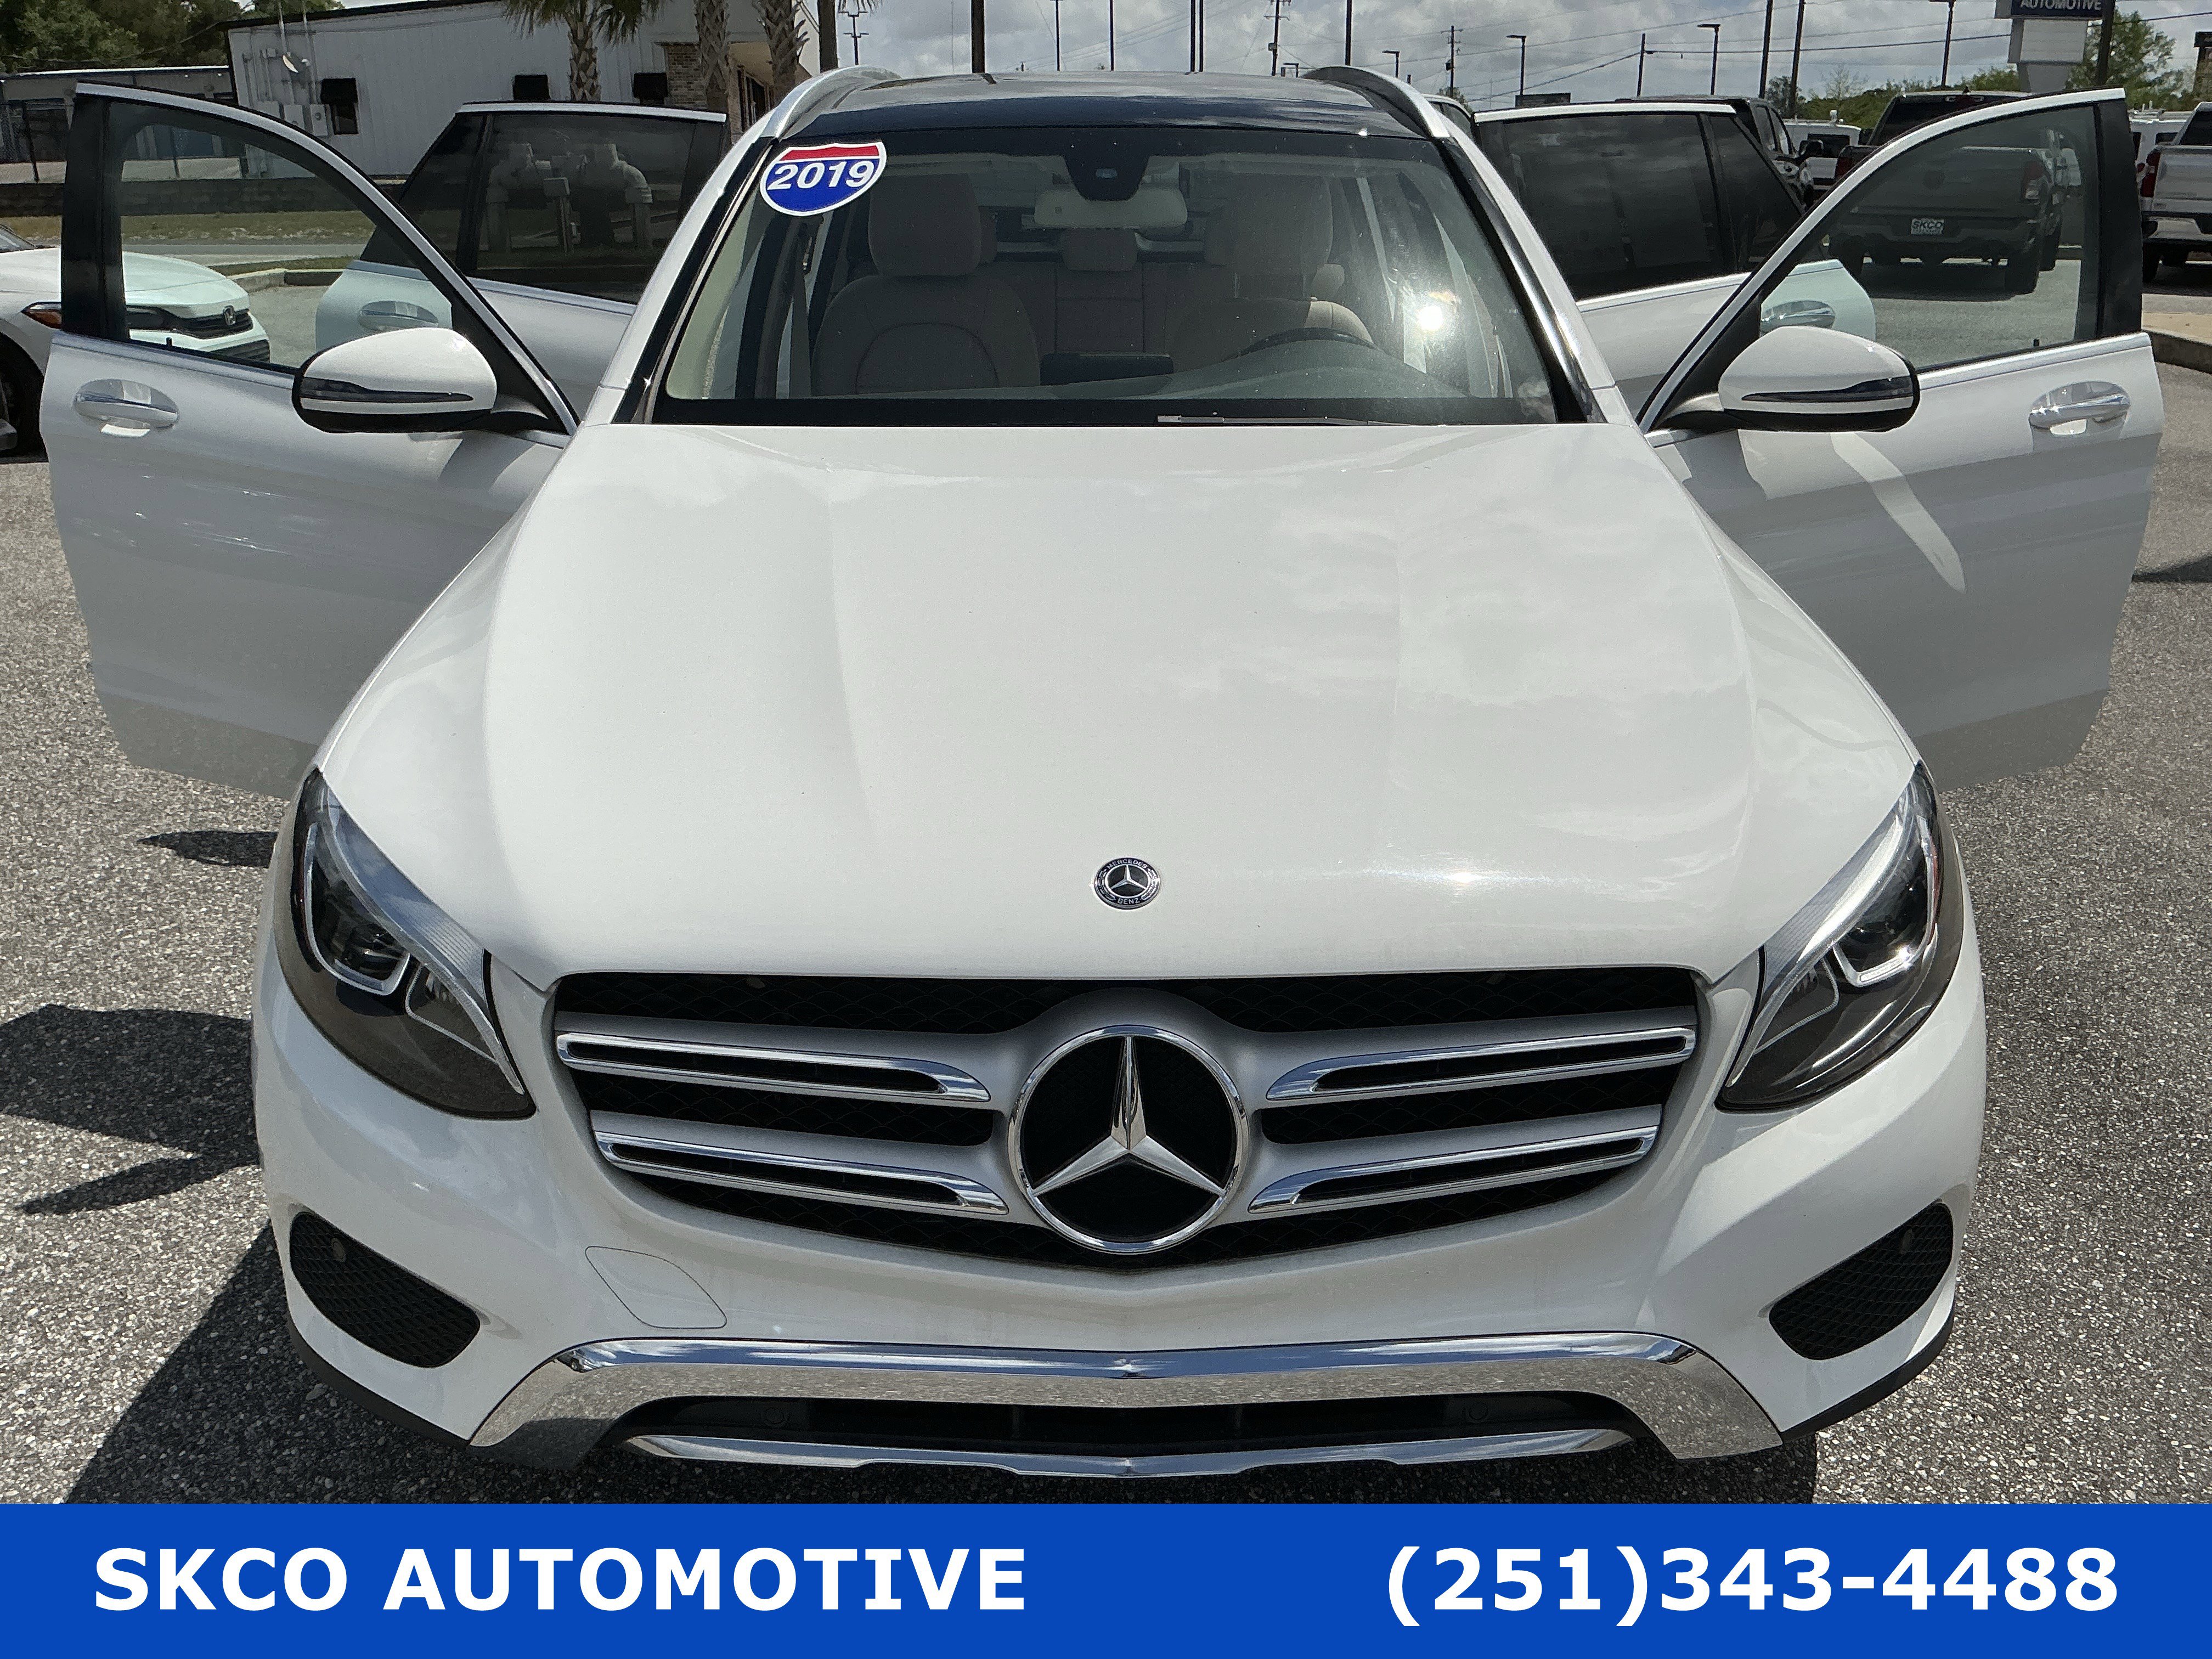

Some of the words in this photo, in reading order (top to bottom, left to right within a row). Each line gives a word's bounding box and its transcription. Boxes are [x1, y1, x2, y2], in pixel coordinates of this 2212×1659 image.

[2020, 0, 2102, 10] AUTOMOTIVE
[767, 161, 874, 190] 2019
[1912, 221, 1943, 229] SKCO
[1106, 859, 1148, 869] MERCEDES
